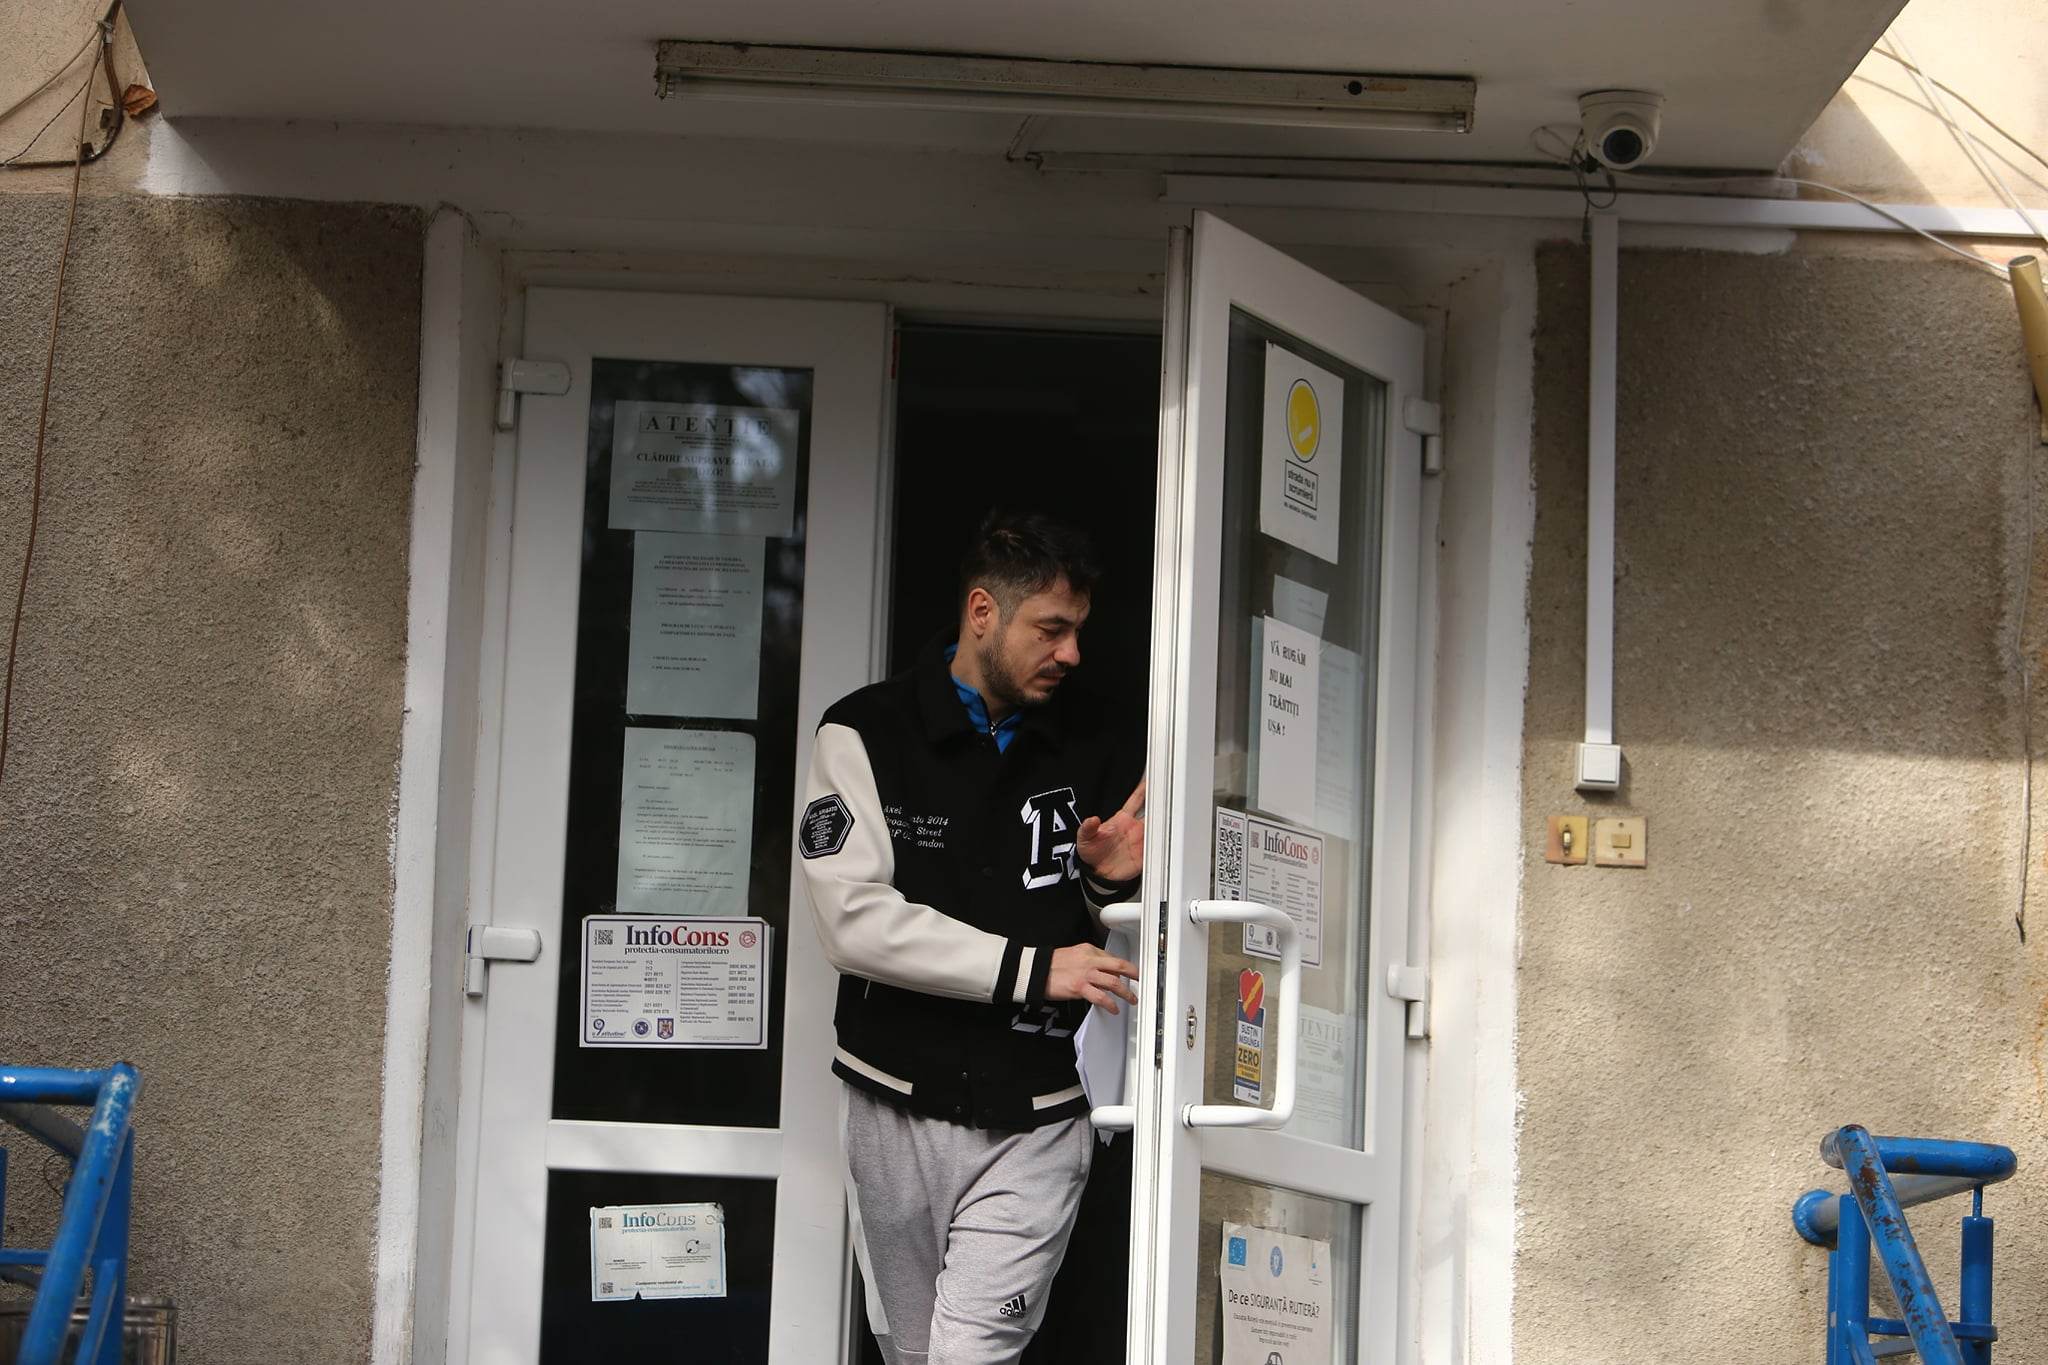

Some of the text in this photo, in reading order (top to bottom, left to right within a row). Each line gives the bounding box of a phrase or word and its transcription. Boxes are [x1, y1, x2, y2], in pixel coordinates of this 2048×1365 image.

[1270, 640, 1306, 666] VĂ RUGĂM
[1269, 668, 1293, 689] NU MAI
[927, 815, 949, 826] 2014
[917, 827, 942, 837] Street
[917, 839, 944, 849] ondon
[1264, 829, 1308, 861] InfoCons
[626, 925, 729, 947] InfoCons
[624, 946, 730, 955] protectia-consumatorilor.ro
[1238, 1047, 1260, 1067] ZERO
[623, 1212, 696, 1227] InfoCons
[1228, 1289, 1320, 1319] De ce SIGURANȚĂ RUTIERĂ?
